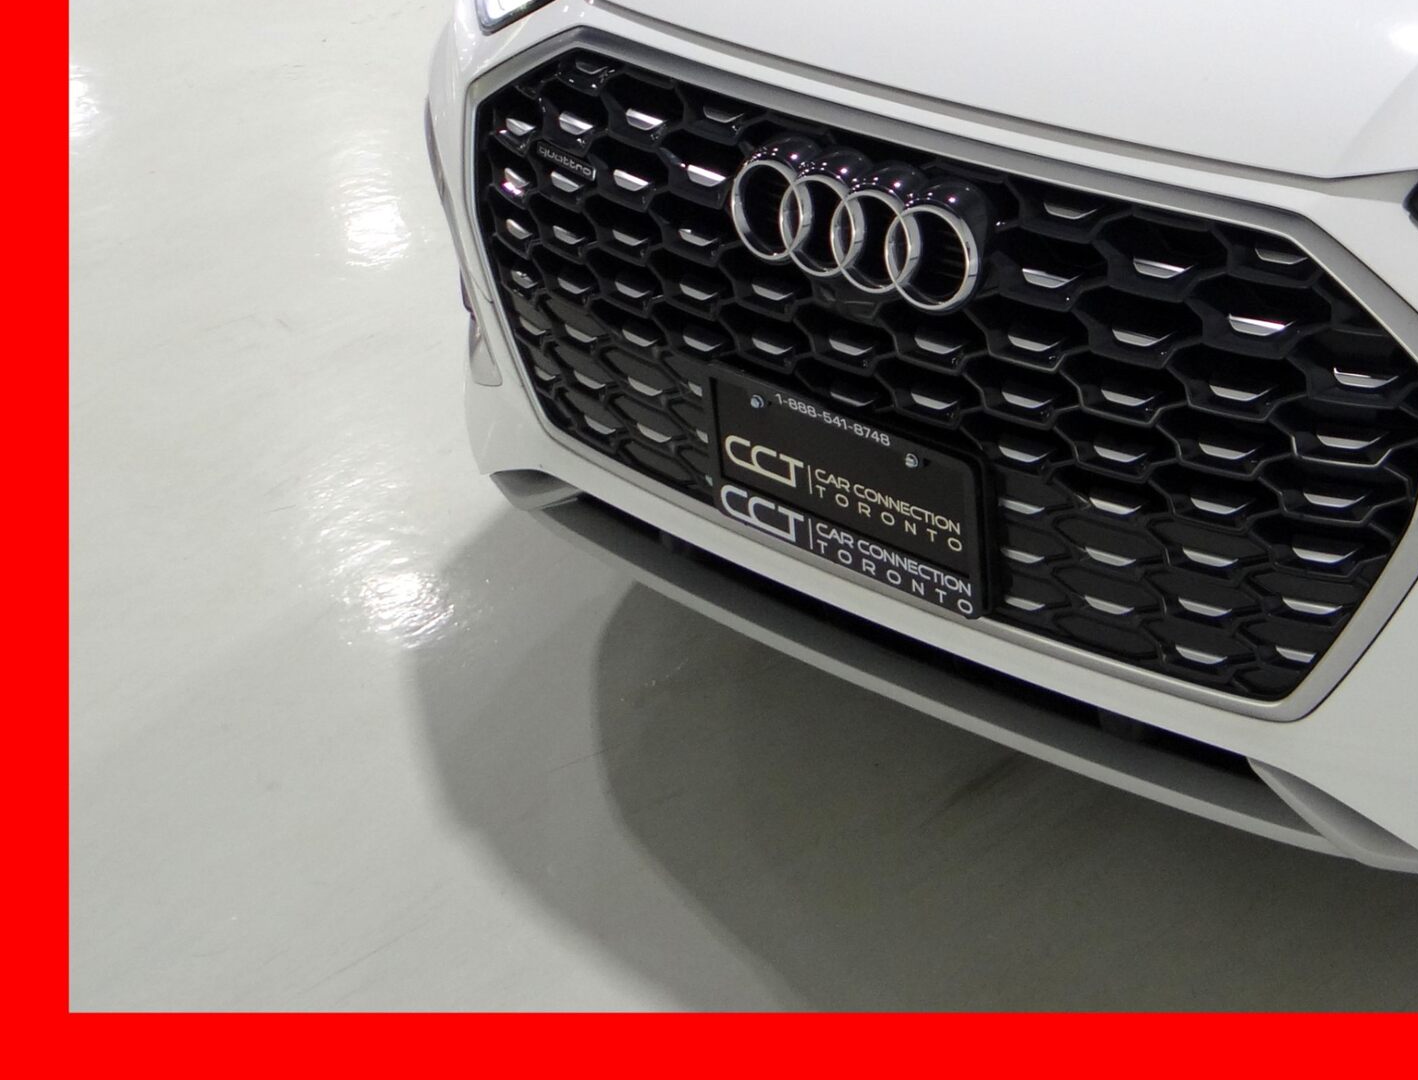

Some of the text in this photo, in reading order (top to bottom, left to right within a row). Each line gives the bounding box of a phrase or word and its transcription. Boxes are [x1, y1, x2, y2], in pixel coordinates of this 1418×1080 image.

[538, 146, 592, 176] quattro
[775, 393, 891, 447] 1-888-541-8748
[724, 434, 804, 488] CCT
[720, 484, 804, 542] CCT
[815, 468, 961, 535] CAR CONNECTION
[816, 486, 962, 552] TORONTO
[816, 523, 972, 596] CAR CONNECTION
[817, 540, 973, 615] TORONTO
